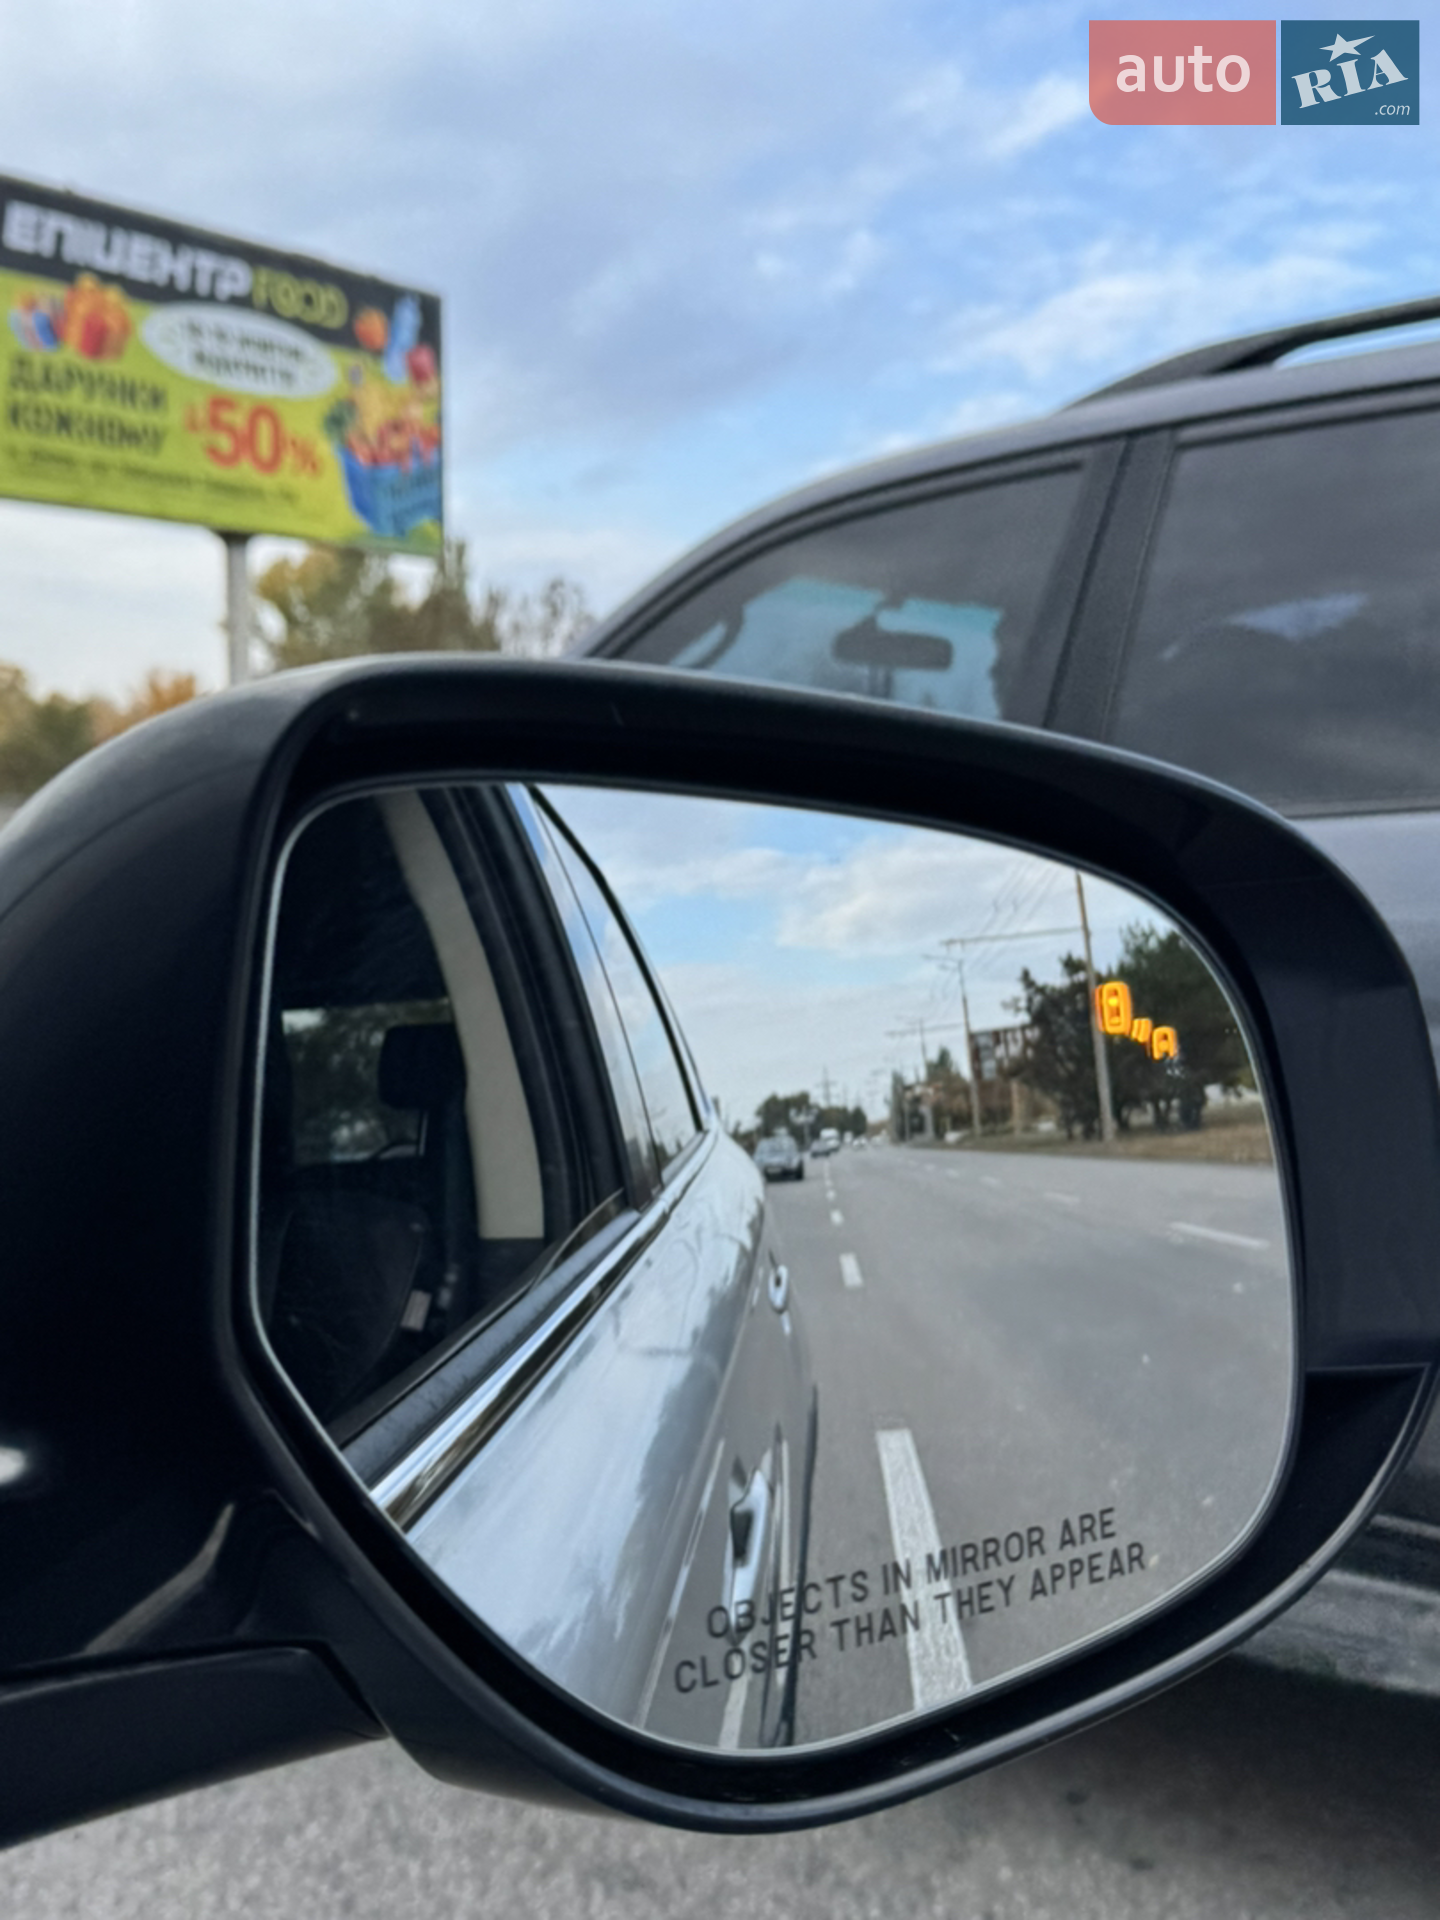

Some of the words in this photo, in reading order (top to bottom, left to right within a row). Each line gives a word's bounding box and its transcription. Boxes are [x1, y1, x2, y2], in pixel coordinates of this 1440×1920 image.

[252, 265, 350, 330] FOOD
[674, 1629, 818, 1695] CLOSER
[831, 1604, 921, 1652] THAN
[935, 1573, 1018, 1625] THEY
[1029, 1541, 1147, 1601] APPEAR
[707, 1571, 870, 1639] OBJECTS
[882, 1559, 913, 1596] IN
[926, 1525, 1045, 1585] MIRROR
[1058, 1507, 1118, 1551] ARE
